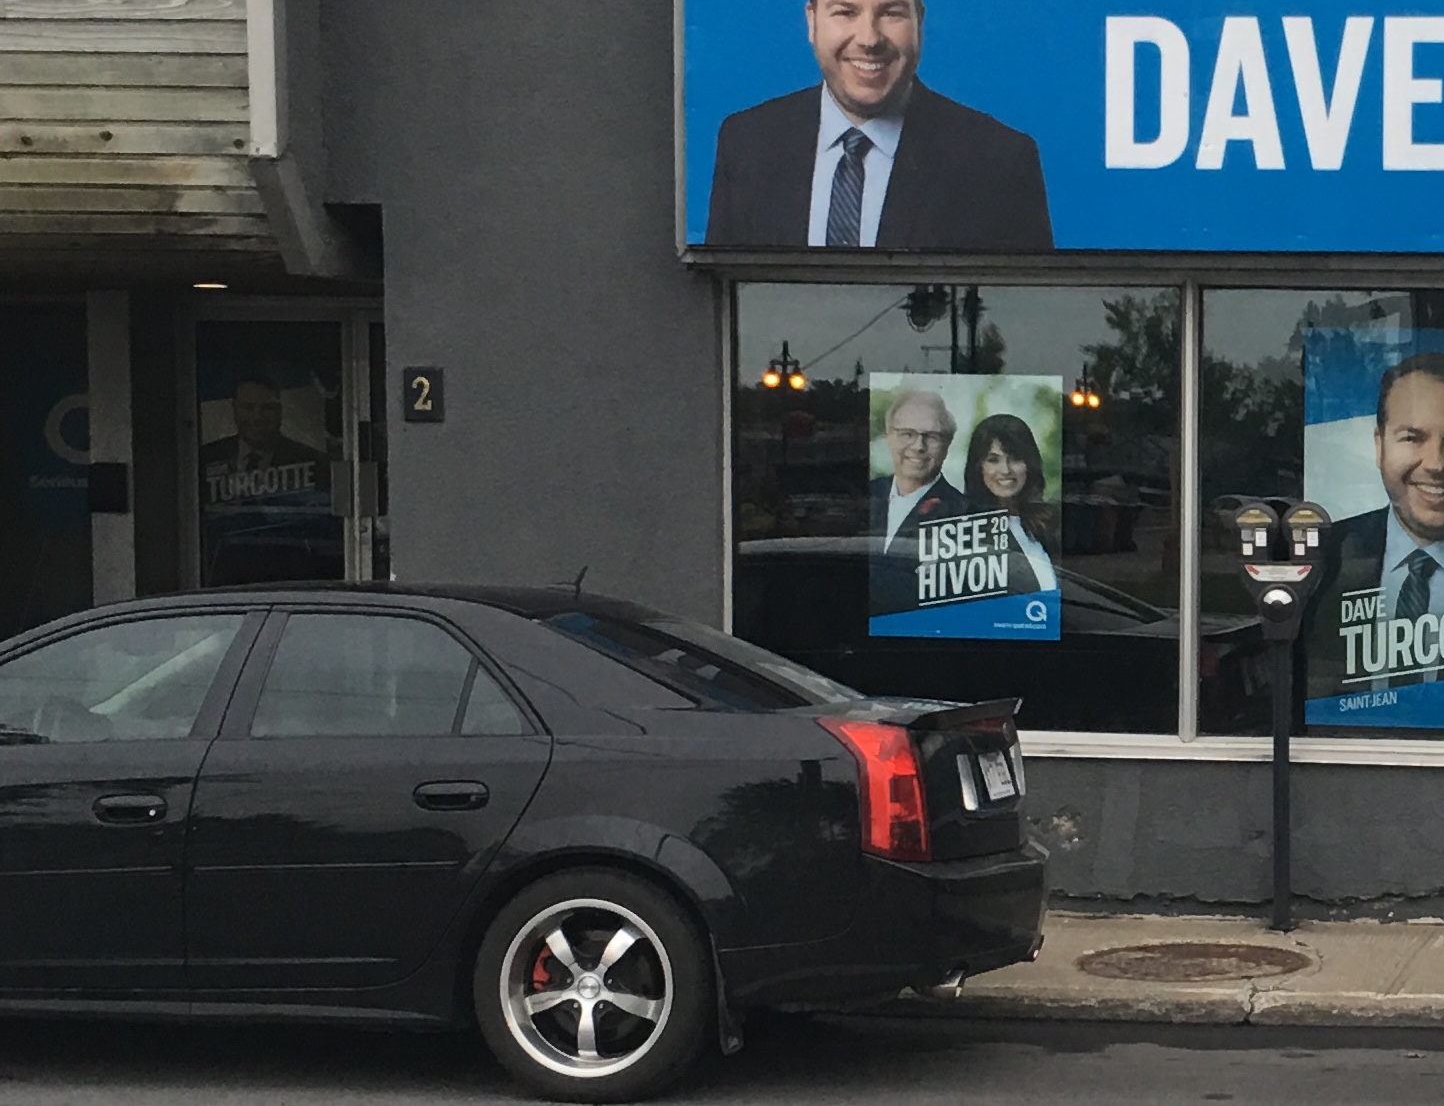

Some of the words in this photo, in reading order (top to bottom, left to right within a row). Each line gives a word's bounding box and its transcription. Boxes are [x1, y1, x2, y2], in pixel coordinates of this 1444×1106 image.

[412, 377, 432, 411] 2
[206, 461, 315, 502] TURCOTTE
[919, 516, 987, 562] LISÉE
[991, 516, 1008, 534] 20
[993, 534, 1008, 551] 18
[918, 554, 1009, 600] HIVON
[1341, 595, 1387, 623] DAVE
[1339, 691, 1398, 712] SAINT-JEAN
